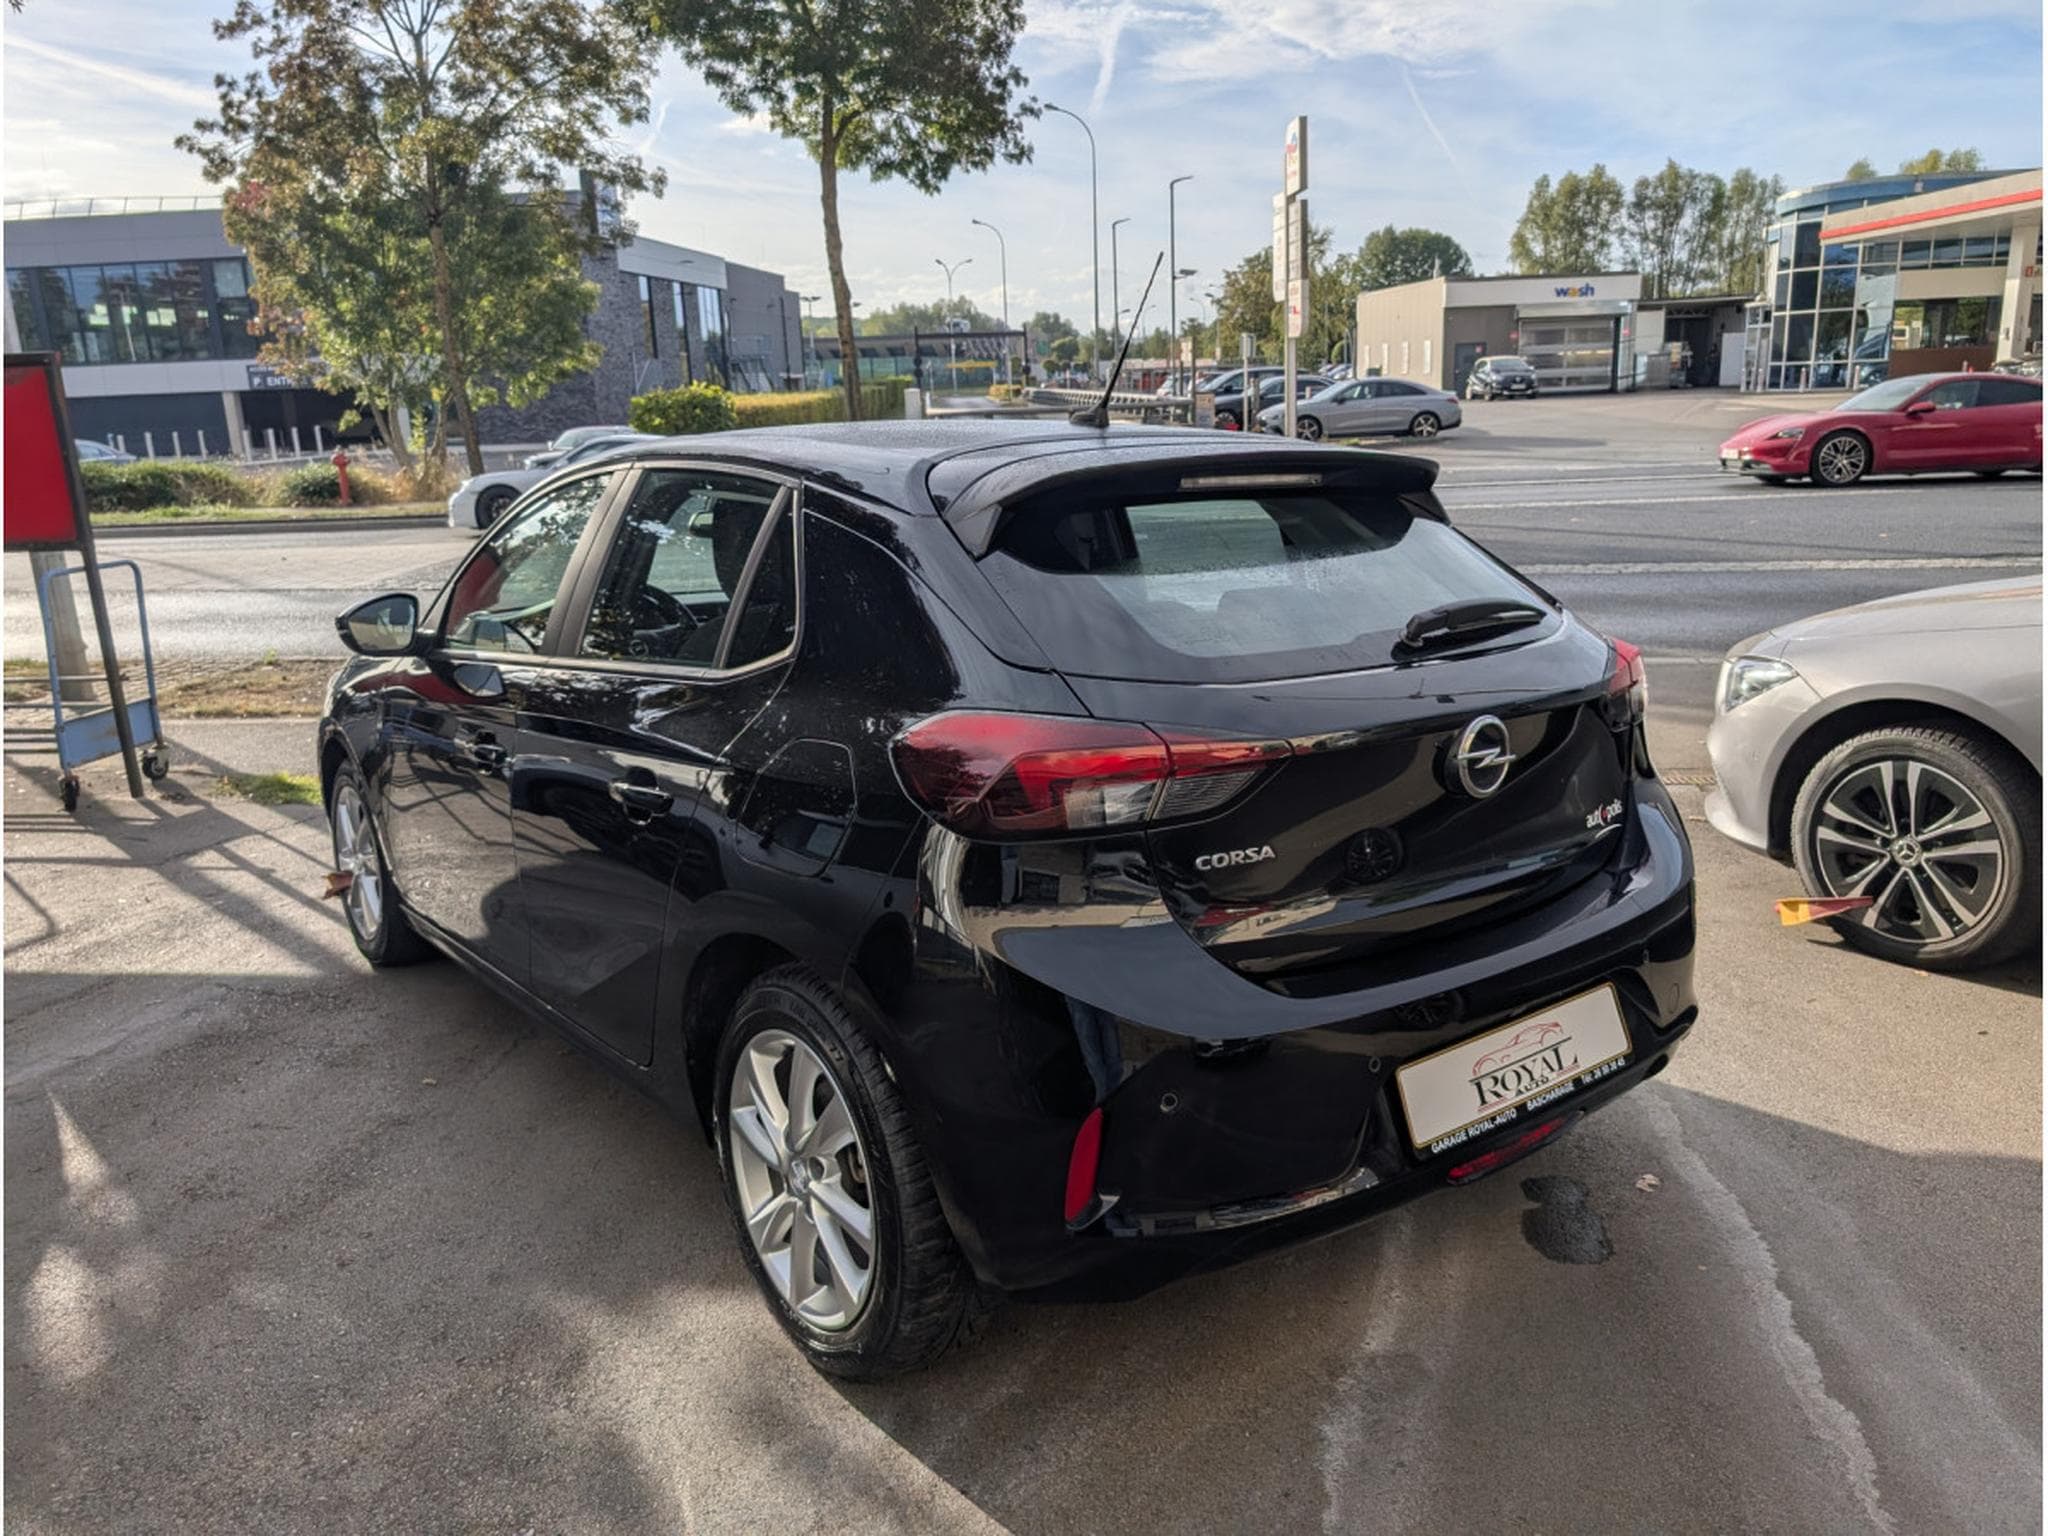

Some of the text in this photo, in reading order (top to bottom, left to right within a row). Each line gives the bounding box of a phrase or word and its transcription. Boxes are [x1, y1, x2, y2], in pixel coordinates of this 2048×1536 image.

[1554, 282, 1595, 298] wash
[1195, 845, 1276, 870] CORSA
[1475, 1046, 1579, 1106] ROYAL
[1515, 1074, 1549, 1097] AUTO
[1431, 1130, 1468, 1154] GARAGE
[1467, 1108, 1517, 1138] ROYAL-AUTO
[1526, 1081, 1575, 1111] BASCHARAGE
